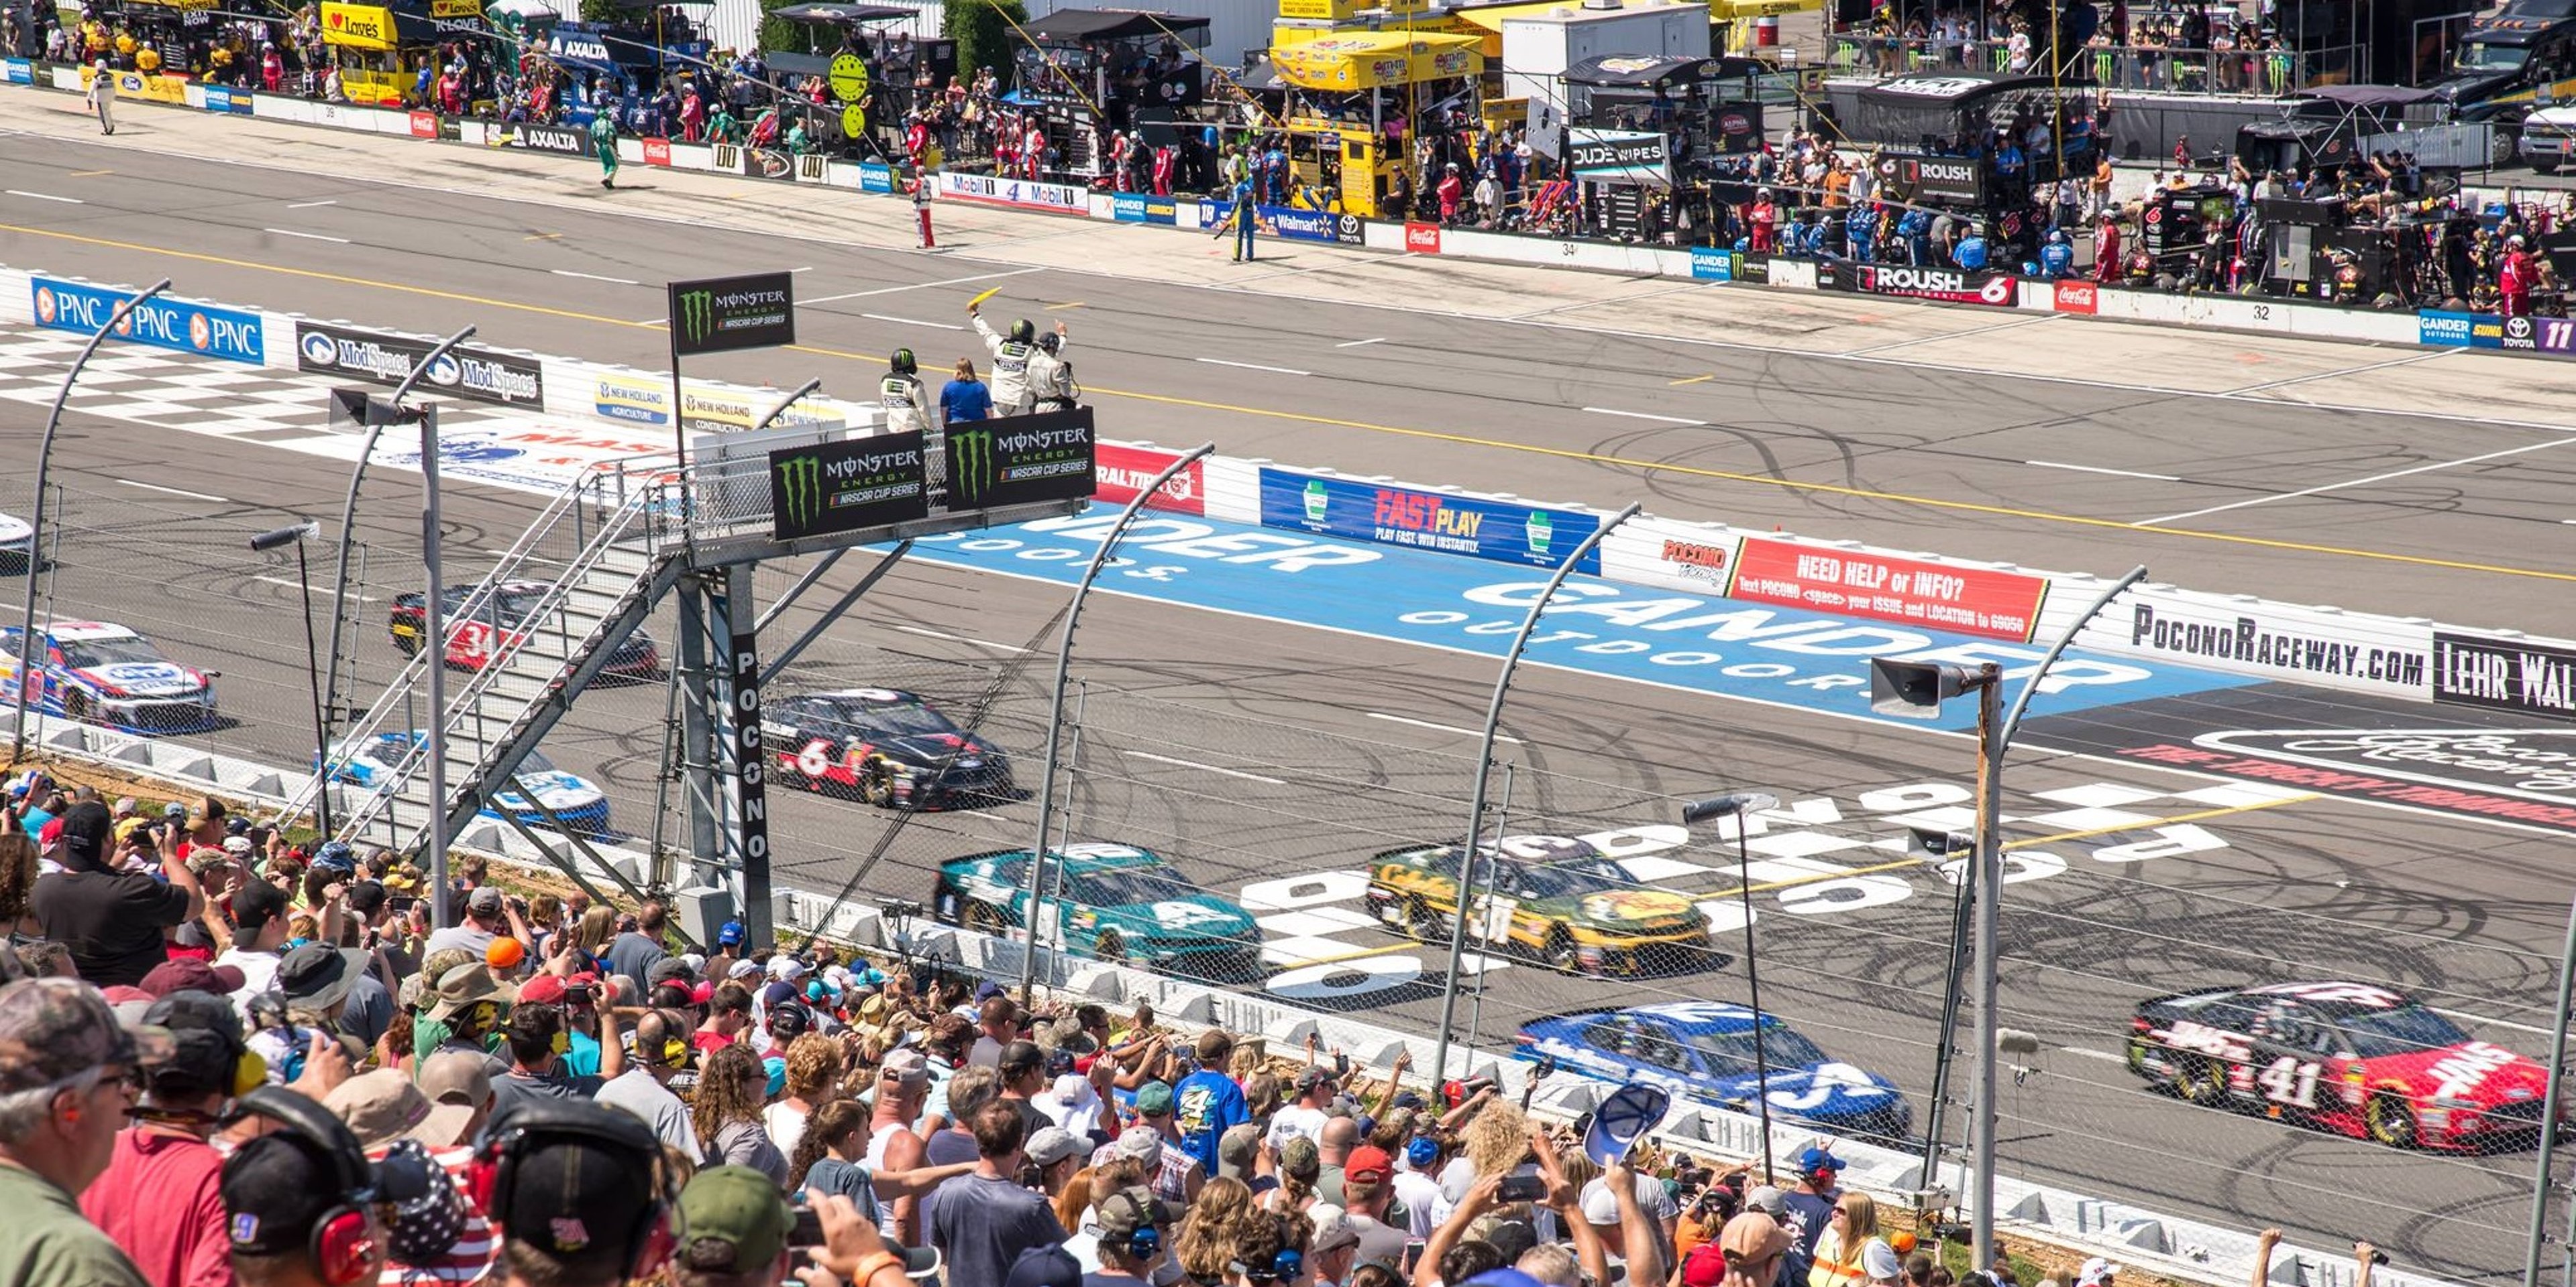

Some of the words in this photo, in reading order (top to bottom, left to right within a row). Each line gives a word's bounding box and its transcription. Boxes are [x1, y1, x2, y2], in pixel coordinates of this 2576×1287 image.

[184, 16, 209, 26] NOW
[345, 17, 378, 38] Love's
[565, 40, 609, 60] AXALTA
[529, 130, 580, 152] AXALTA
[1572, 147, 1615, 165] DUDE
[1617, 146, 1662, 162] WIPES
[861, 169, 890, 182] GANDER
[1882, 159, 1896, 174] 6
[1921, 163, 1973, 182] ROUSH
[953, 176, 983, 194] Mobil
[985, 179, 995, 195] 1
[1008, 183, 1020, 202] 4
[1031, 185, 1062, 204] Mobil
[1114, 198, 1145, 211] GANDER
[2146, 207, 2162, 223] 6
[1200, 203, 1214, 222] 18
[1277, 213, 1319, 233] Walmart
[1340, 234, 1361, 244] TOYOTA
[1409, 228, 1437, 246] Coca-Cola
[1562, 243, 1574, 257] 34
[1693, 254, 1730, 267] GANDER
[1877, 268, 1963, 292] ROUSH
[1980, 278, 2008, 302] 6
[716, 290, 786, 309] MONSTER
[2058, 286, 2093, 306] Coca-Cola
[58, 292, 104, 329] PNC
[136, 306, 180, 343] PNC
[211, 317, 259, 355] PNC
[2253, 306, 2269, 320] 32
[2420, 318, 2470, 332] GANDER
[2546, 322, 2573, 348] 11
[2503, 337, 2535, 349] TOYOTA
[338, 339, 411, 379] ModSpace
[462, 358, 537, 402] ModSpace
[611, 386, 628, 398] NEW
[629, 388, 662, 404] HOLLAND
[611, 406, 653, 422] AGRICULTURE
[696, 400, 714, 413] NEW
[715, 402, 750, 418] HOLLAND
[998, 427, 1089, 453] MONSTER
[826, 450, 920, 478] MONSTER
[1012, 448, 1075, 463] ENERGY
[841, 471, 907, 488] ENERGY
[1011, 465, 1043, 480] NASCAR
[1044, 463, 1059, 476] CUP
[1060, 459, 1088, 474] SERIES
[841, 489, 873, 504] NASCAR
[874, 487, 892, 500] CUP
[892, 482, 920, 498] SERIES
[1375, 489, 1443, 531] FAST
[1436, 508, 1484, 538] PLAY
[1375, 527, 1395, 541] PLAY
[1396, 529, 1417, 545] FAST.
[1417, 533, 1436, 548] WIN
[1436, 535, 1479, 554] INSTANTLY.
[1662, 539, 1725, 567] POCONO
[1796, 555, 1839, 583] NEED
[1845, 561, 1888, 589] HELP
[1892, 573, 1910, 594] or
[1914, 573, 1965, 602] INFO?
[1739, 575, 1760, 596] Text
[1761, 580, 1801, 601] POCONO
[1803, 587, 1846, 608] <space>
[1848, 594, 1870, 612] your
[1873, 596, 1903, 616] ISSUE
[1904, 602, 1924, 618] and
[1926, 603, 1976, 626] LOCATION
[1978, 612, 1989, 627] to
[1990, 615, 2025, 634] 69050
[1462, 582, 2153, 694] GANDER
[1399, 611, 1872, 696] OUTDOOR
[737, 652, 767, 858] POCONO
[798, 738, 829, 777] 6
[2258, 1056, 2322, 1109] 41
[231, 1212, 260, 1243] 9
